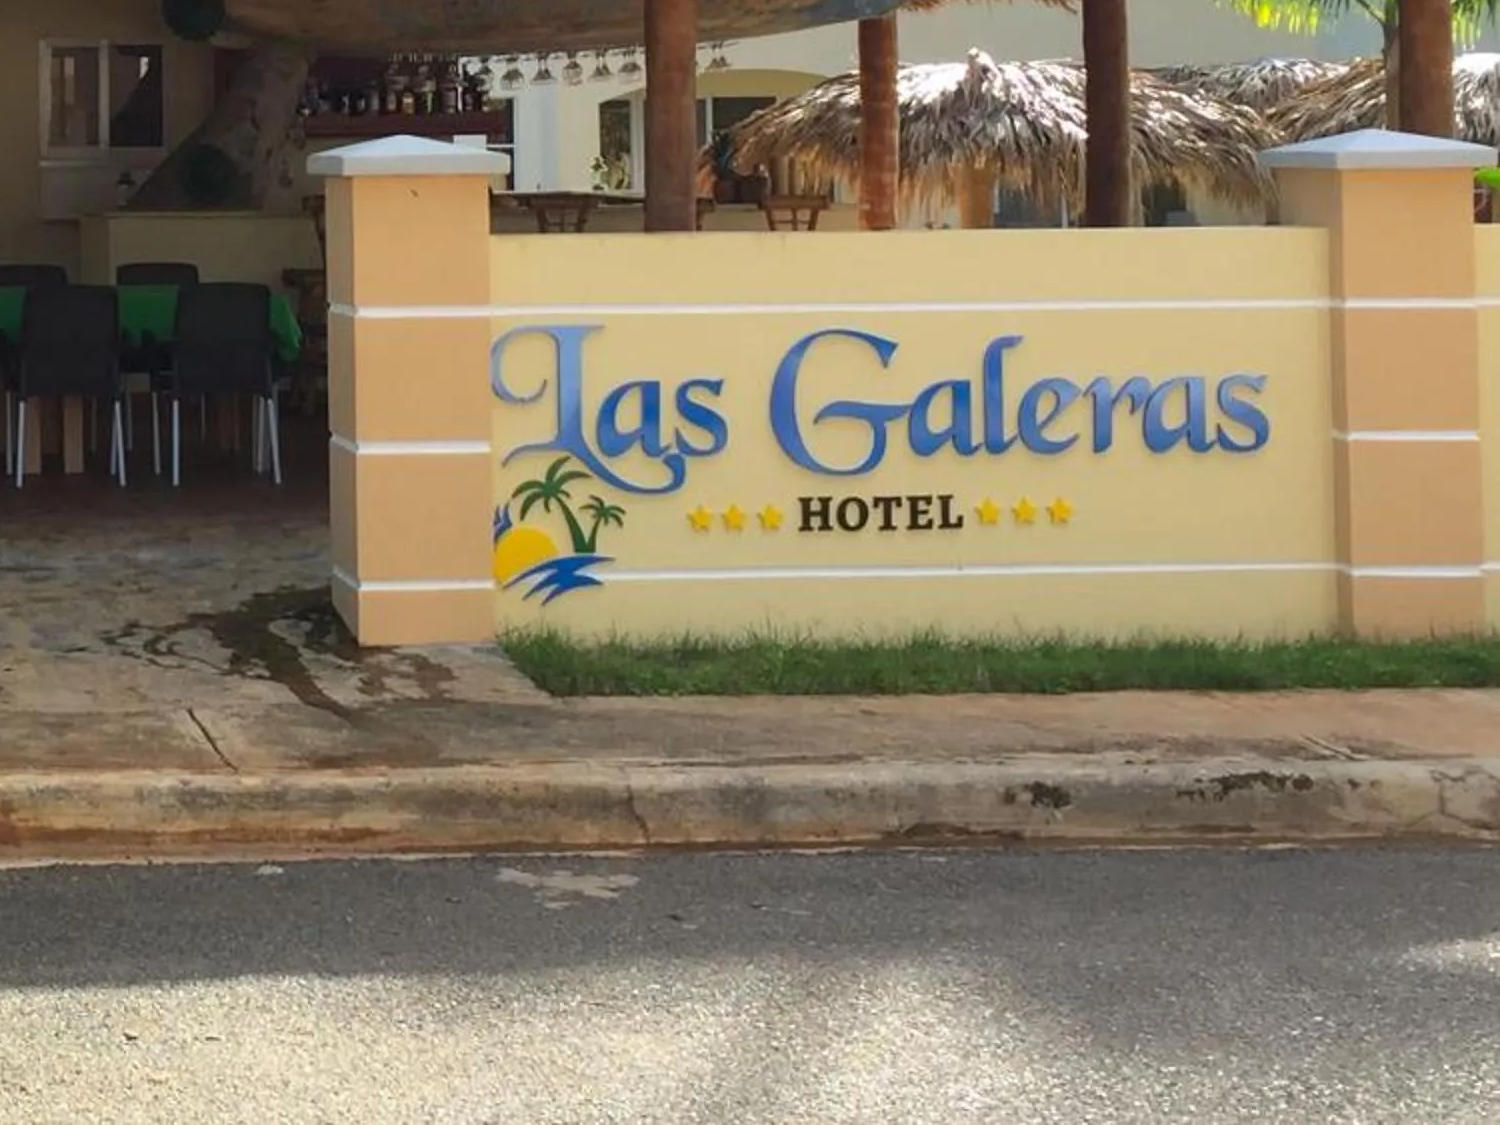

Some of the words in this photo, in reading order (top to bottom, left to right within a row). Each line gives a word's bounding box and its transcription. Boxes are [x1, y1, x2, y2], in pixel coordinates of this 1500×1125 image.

[490, 323, 729, 494] Las
[769, 328, 1270, 476] Galeras
[796, 494, 964, 532] HOTEL
